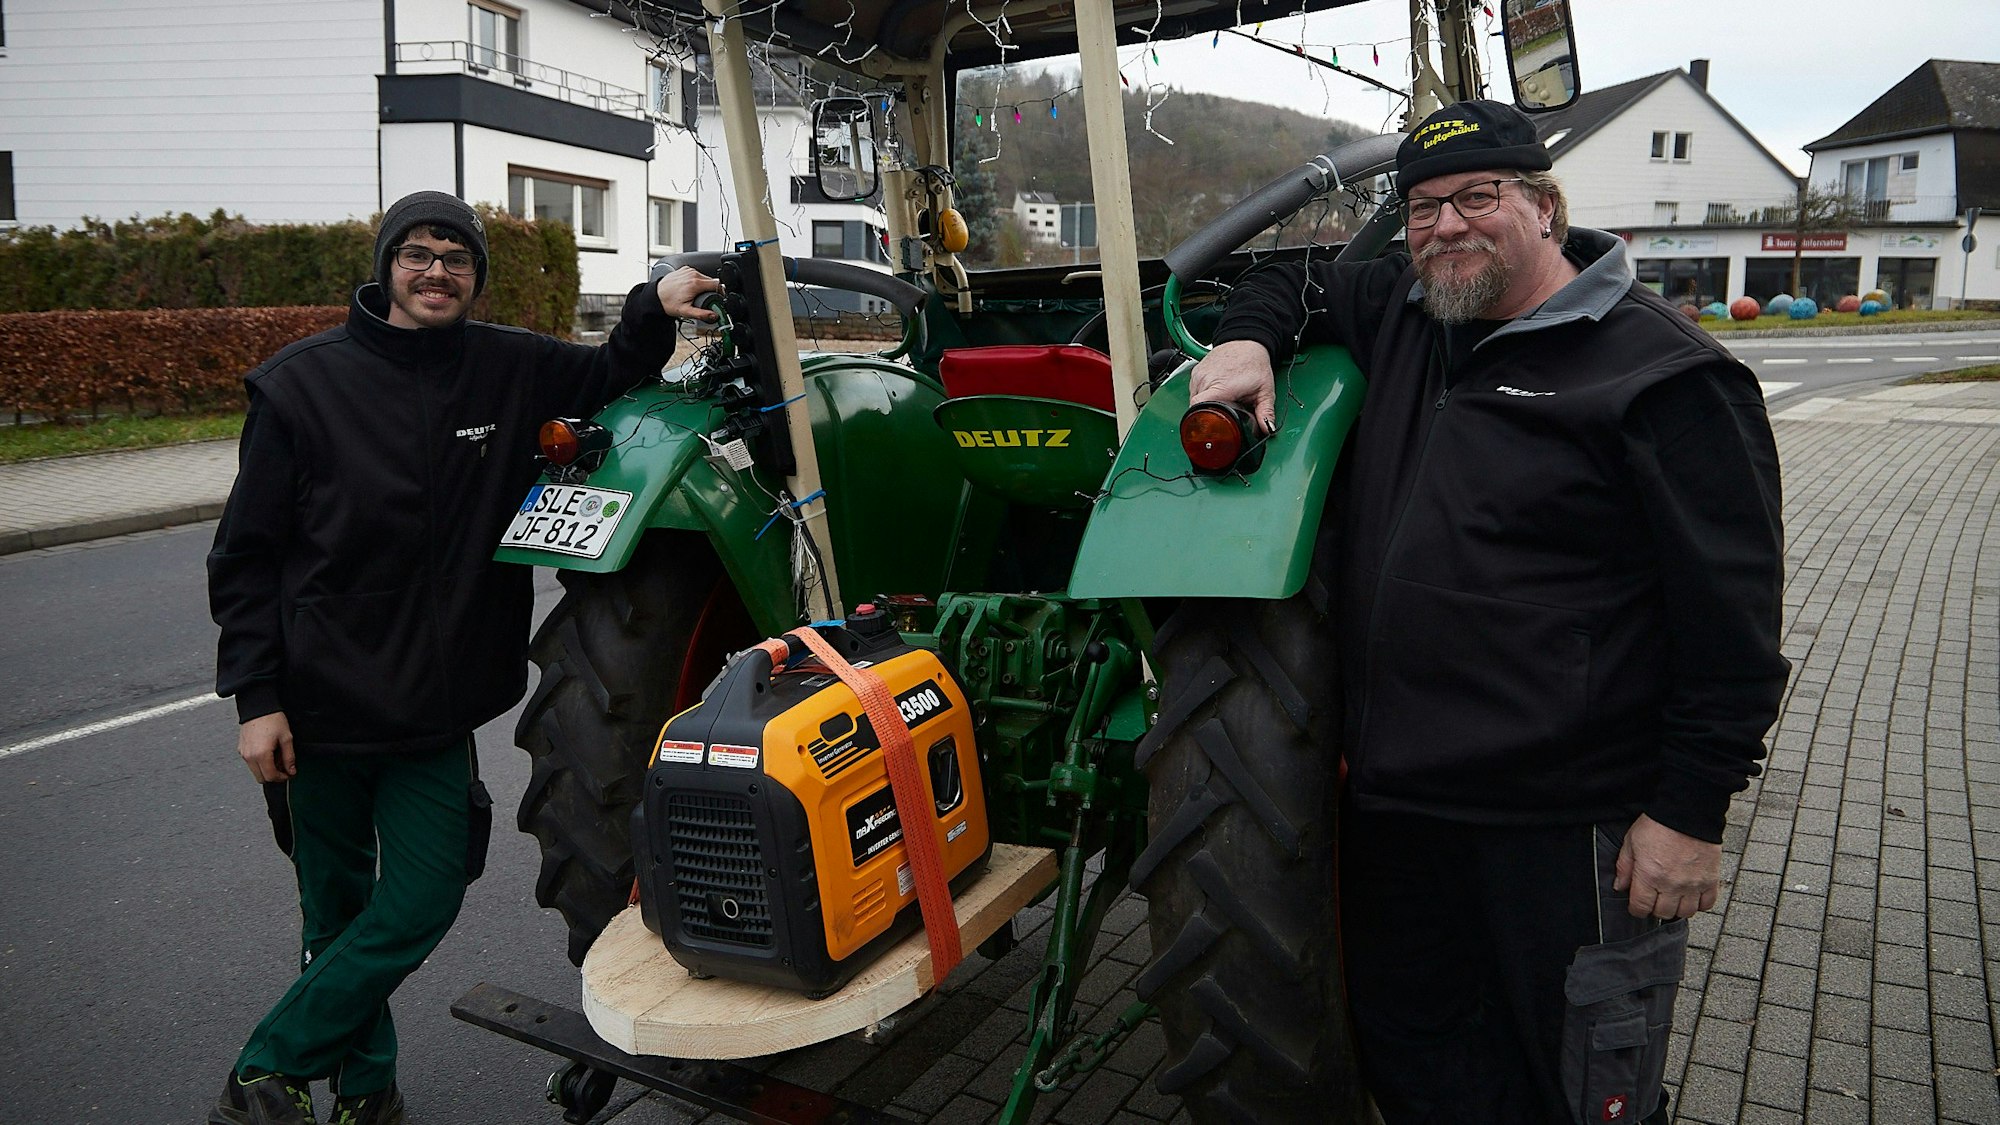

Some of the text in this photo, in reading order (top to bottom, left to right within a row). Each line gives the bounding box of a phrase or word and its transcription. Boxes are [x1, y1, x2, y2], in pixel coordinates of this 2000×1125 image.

[456, 423, 496, 437] DEUTZ
[952, 429, 1072, 448] DEUTZ
[534, 487, 587, 517] SLE
[512, 516, 599, 550] JF 812
